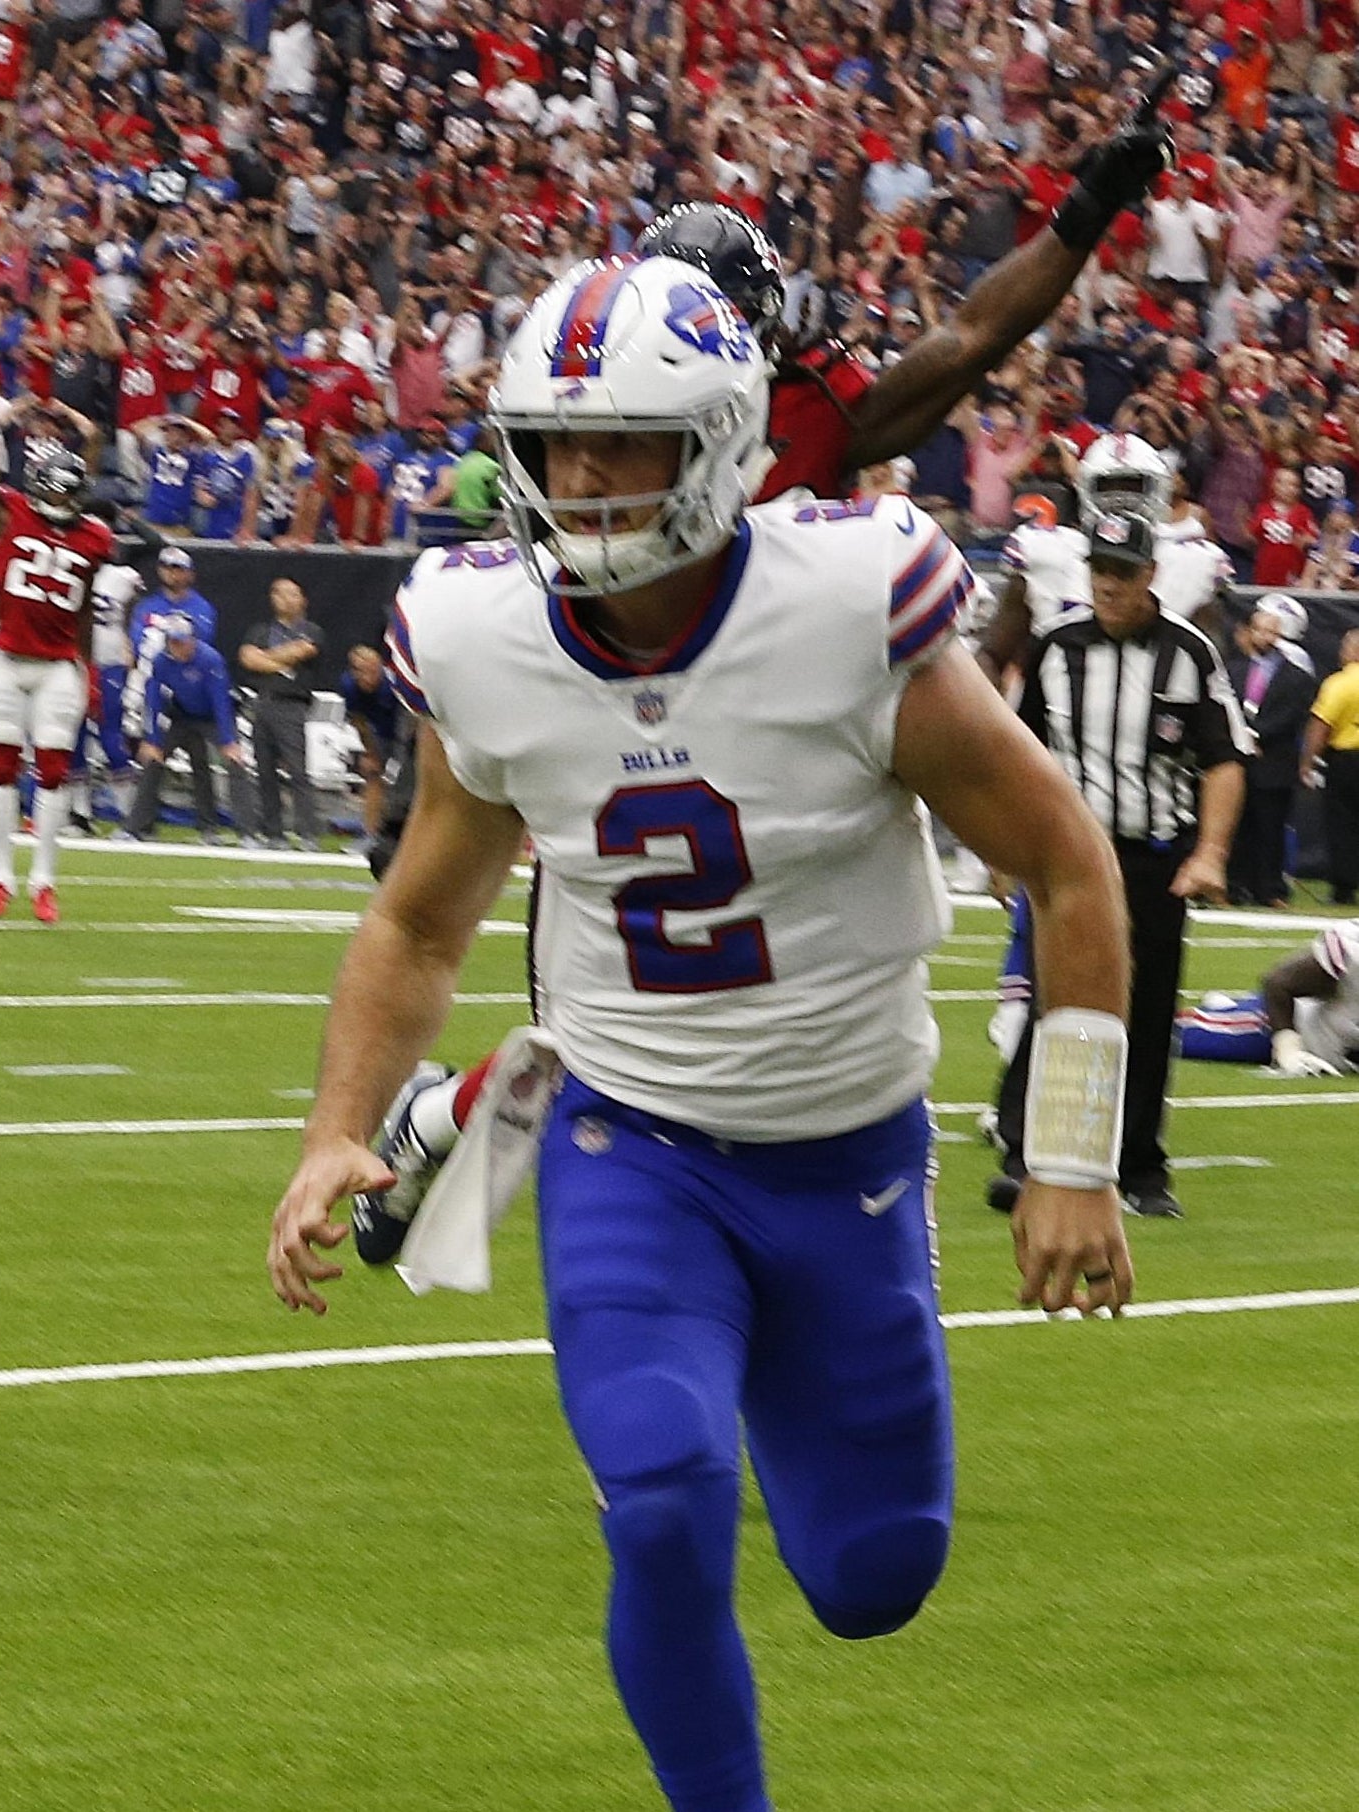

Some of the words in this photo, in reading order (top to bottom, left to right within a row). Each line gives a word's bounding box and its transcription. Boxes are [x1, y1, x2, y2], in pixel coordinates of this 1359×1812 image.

[4, 535, 91, 612] 25
[620, 746, 692, 773] BILLS
[596, 781, 772, 994] 2
